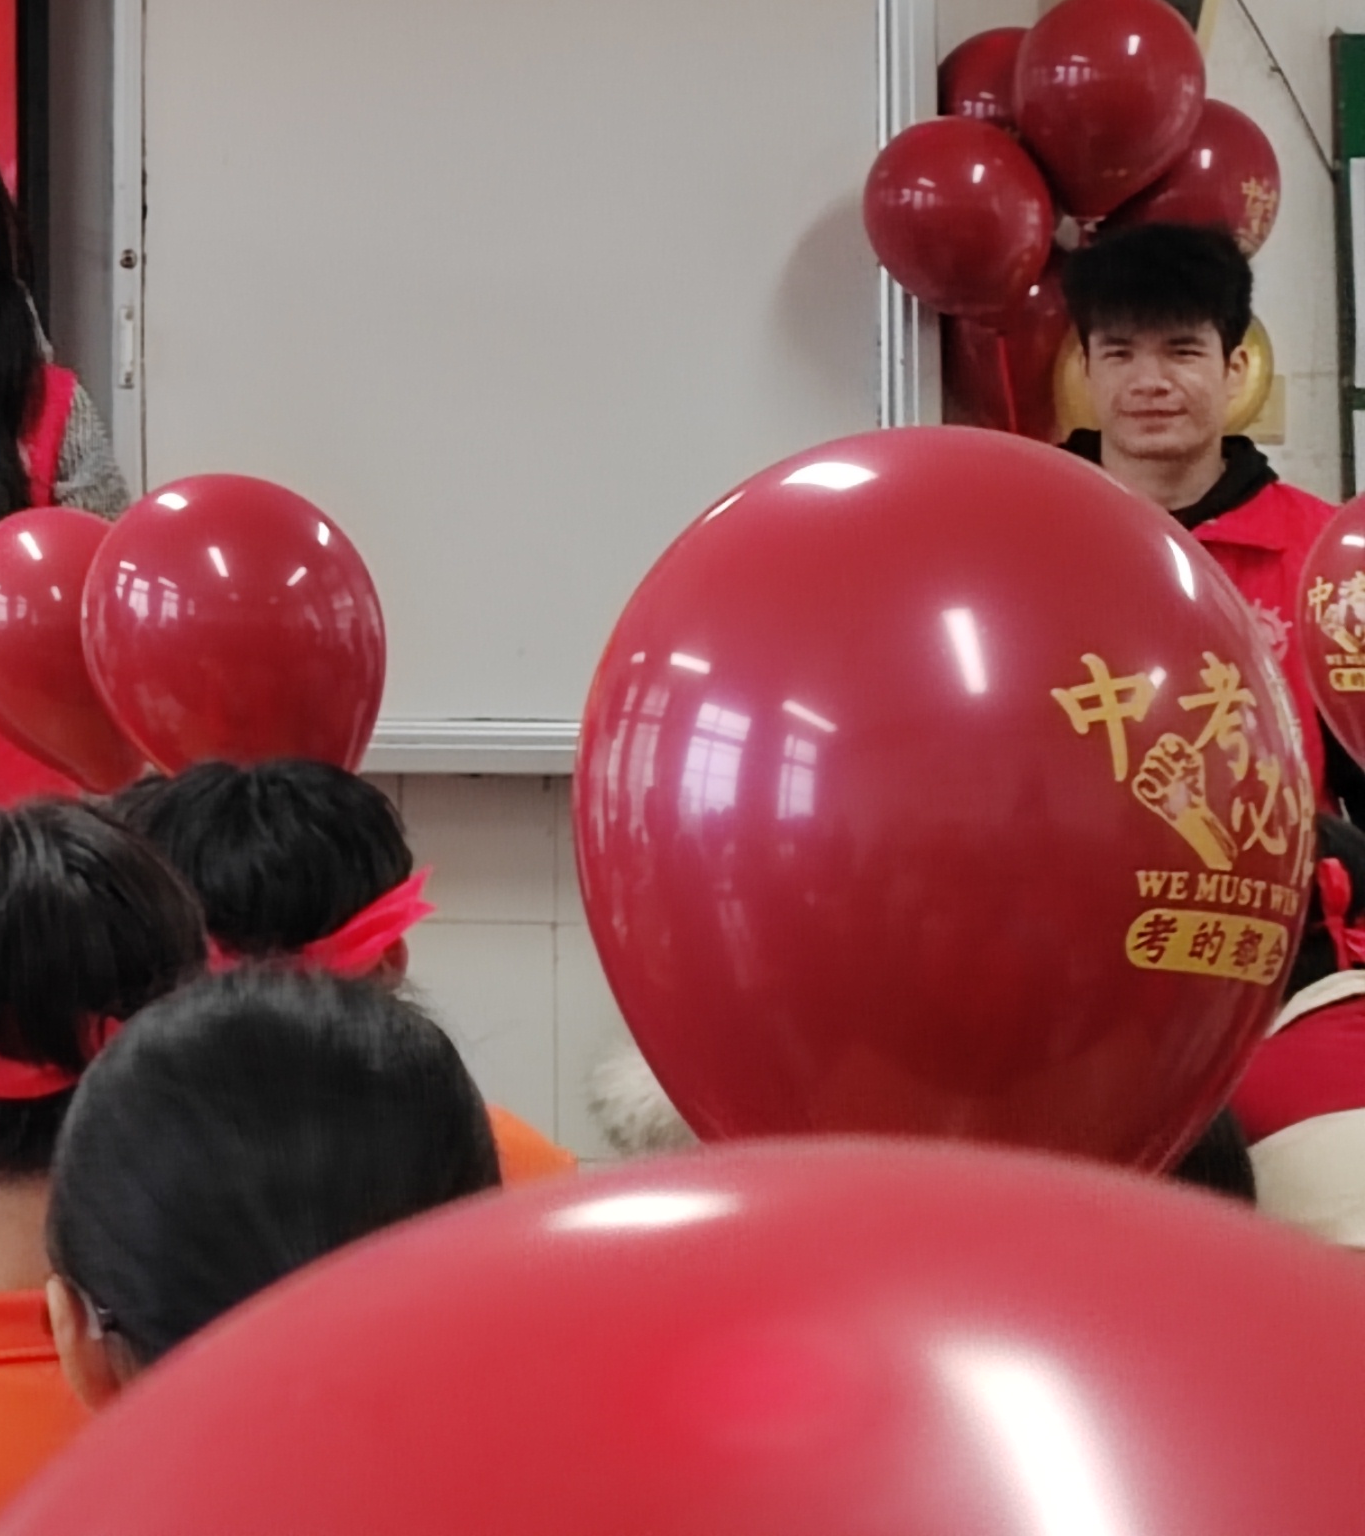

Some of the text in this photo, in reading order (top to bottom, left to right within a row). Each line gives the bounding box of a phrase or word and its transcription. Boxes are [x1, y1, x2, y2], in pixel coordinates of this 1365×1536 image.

[1051, 651, 1256, 782] 中考
[1135, 870, 1189, 900] WE
[1194, 872, 1267, 908] MUST
